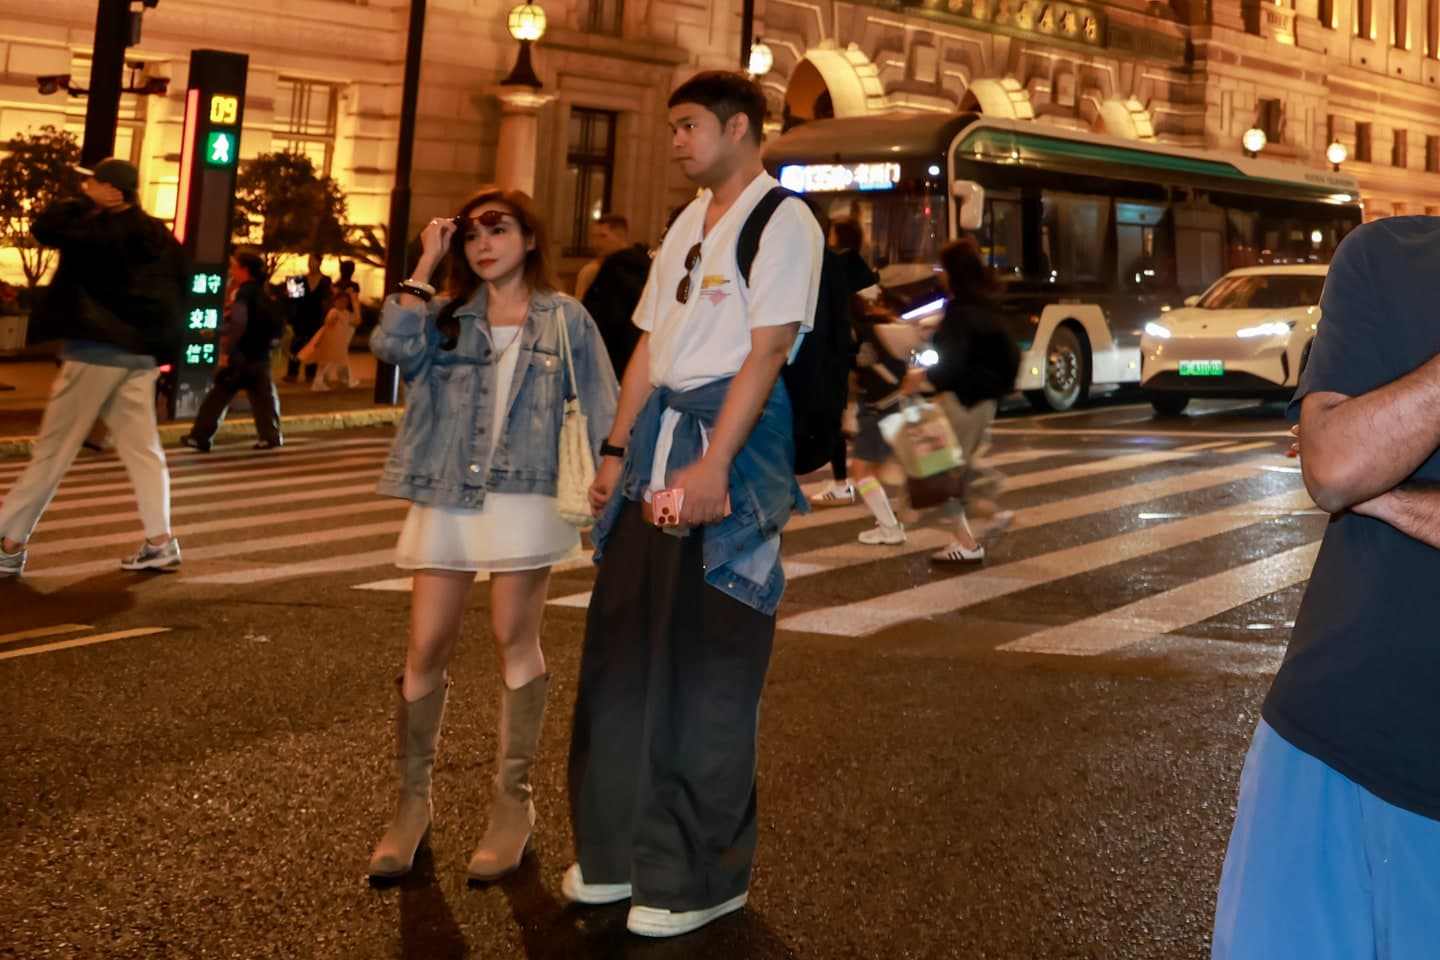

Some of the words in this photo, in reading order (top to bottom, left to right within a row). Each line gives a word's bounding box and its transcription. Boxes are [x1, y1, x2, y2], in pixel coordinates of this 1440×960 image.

[210, 95, 238, 124] 09
[192, 273, 221, 294] 遵守
[189, 308, 217, 329] 交通
[186, 344, 214, 364] 信号
